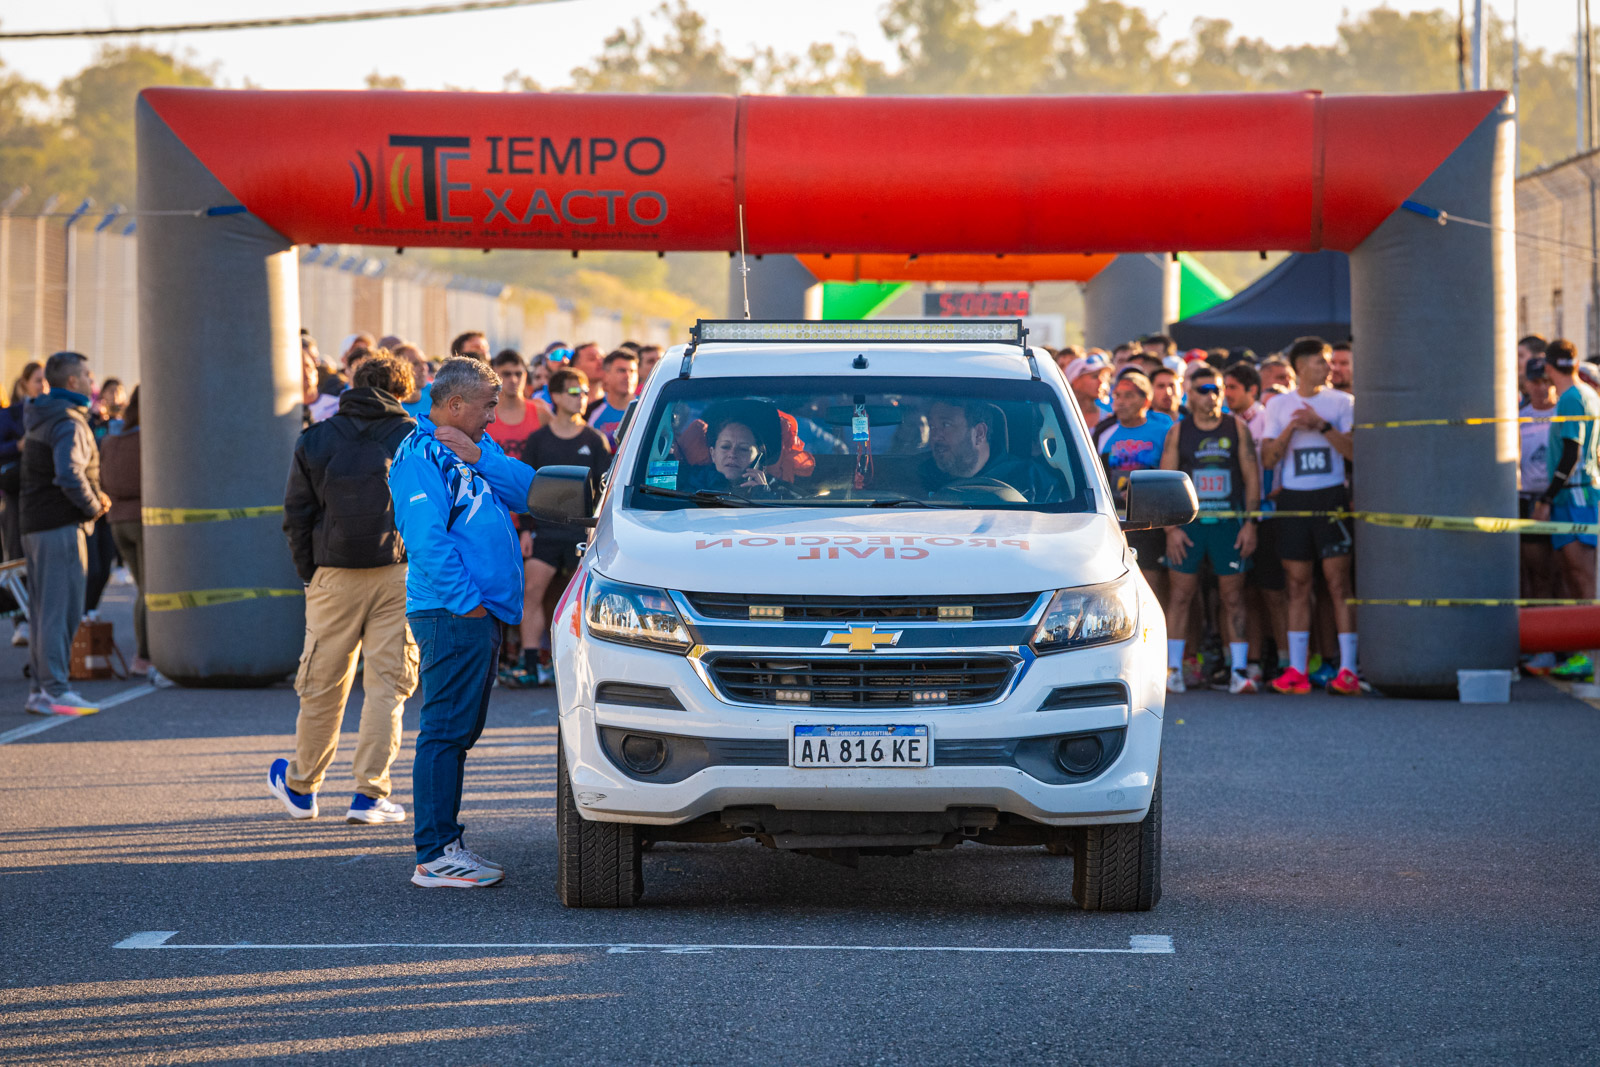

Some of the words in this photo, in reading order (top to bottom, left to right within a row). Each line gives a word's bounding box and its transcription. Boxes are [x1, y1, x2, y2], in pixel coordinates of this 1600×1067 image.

[1301, 452, 1326, 470] 106
[1200, 476, 1224, 492] 317
[802, 739, 829, 762] AA
[840, 739, 884, 762] 816
[893, 739, 920, 762] KE
